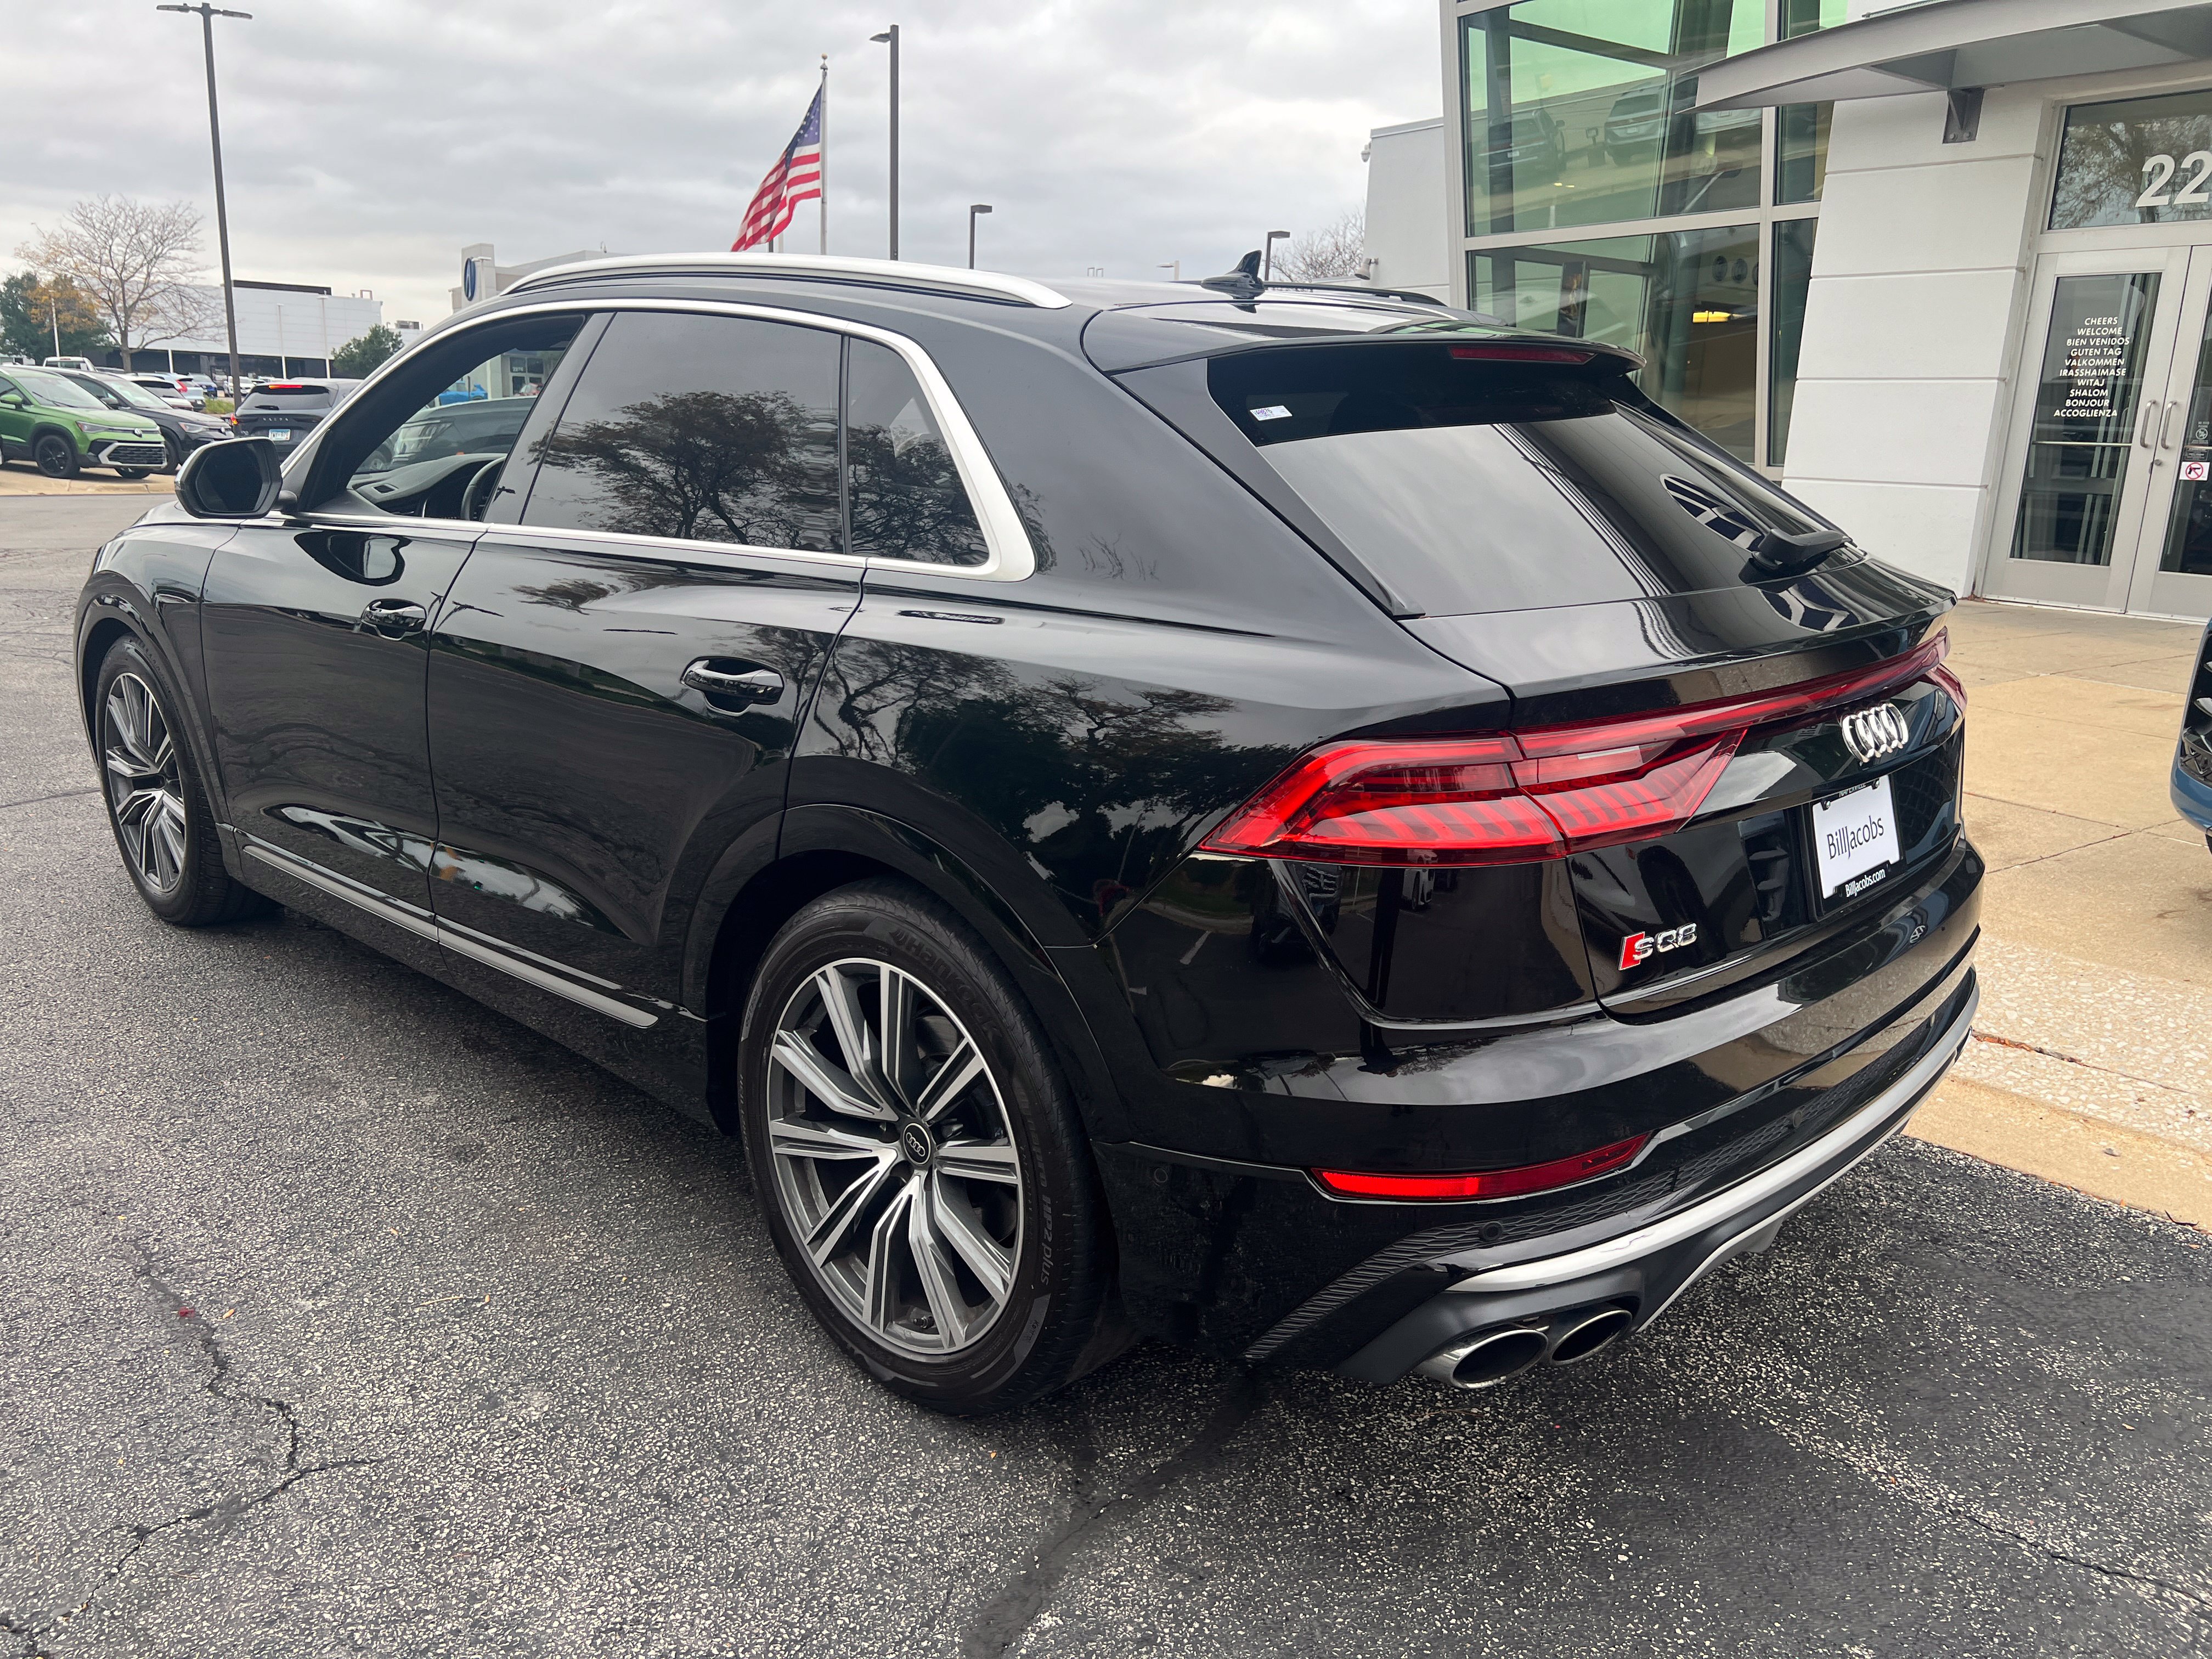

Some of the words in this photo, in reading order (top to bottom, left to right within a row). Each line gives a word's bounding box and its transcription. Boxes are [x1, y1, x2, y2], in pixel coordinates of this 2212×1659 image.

[2084, 317, 2118, 325] CHEERS
[2077, 327, 2123, 336] WELCOME
[2089, 337, 2130, 346] VENIDOS
[2070, 348, 2101, 357] GUTEN
[2064, 358, 2125, 366] VALKOMMEN
[2059, 368, 2126, 377] IRASSHAIMASE
[2077, 379, 2106, 387] WITAJ
[2069, 388, 2108, 397] SHALOM
[2065, 399, 2110, 407] BONJOUR
[2053, 409, 2118, 417] ACCOGLIENZA
